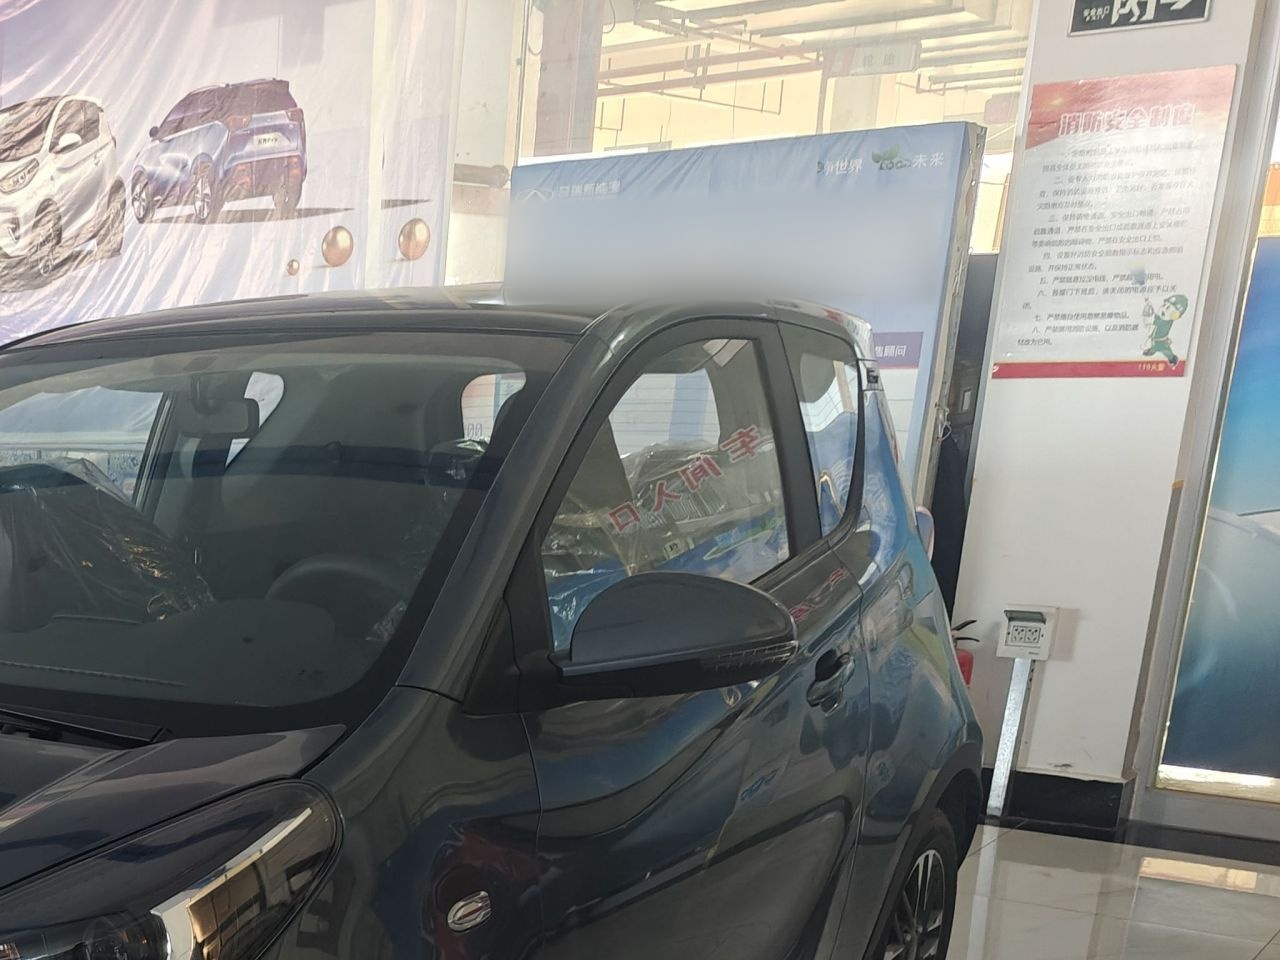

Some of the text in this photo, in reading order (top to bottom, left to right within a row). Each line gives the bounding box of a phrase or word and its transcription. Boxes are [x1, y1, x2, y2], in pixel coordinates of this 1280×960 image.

[1058, 102, 1197, 138] 消防安全制度
